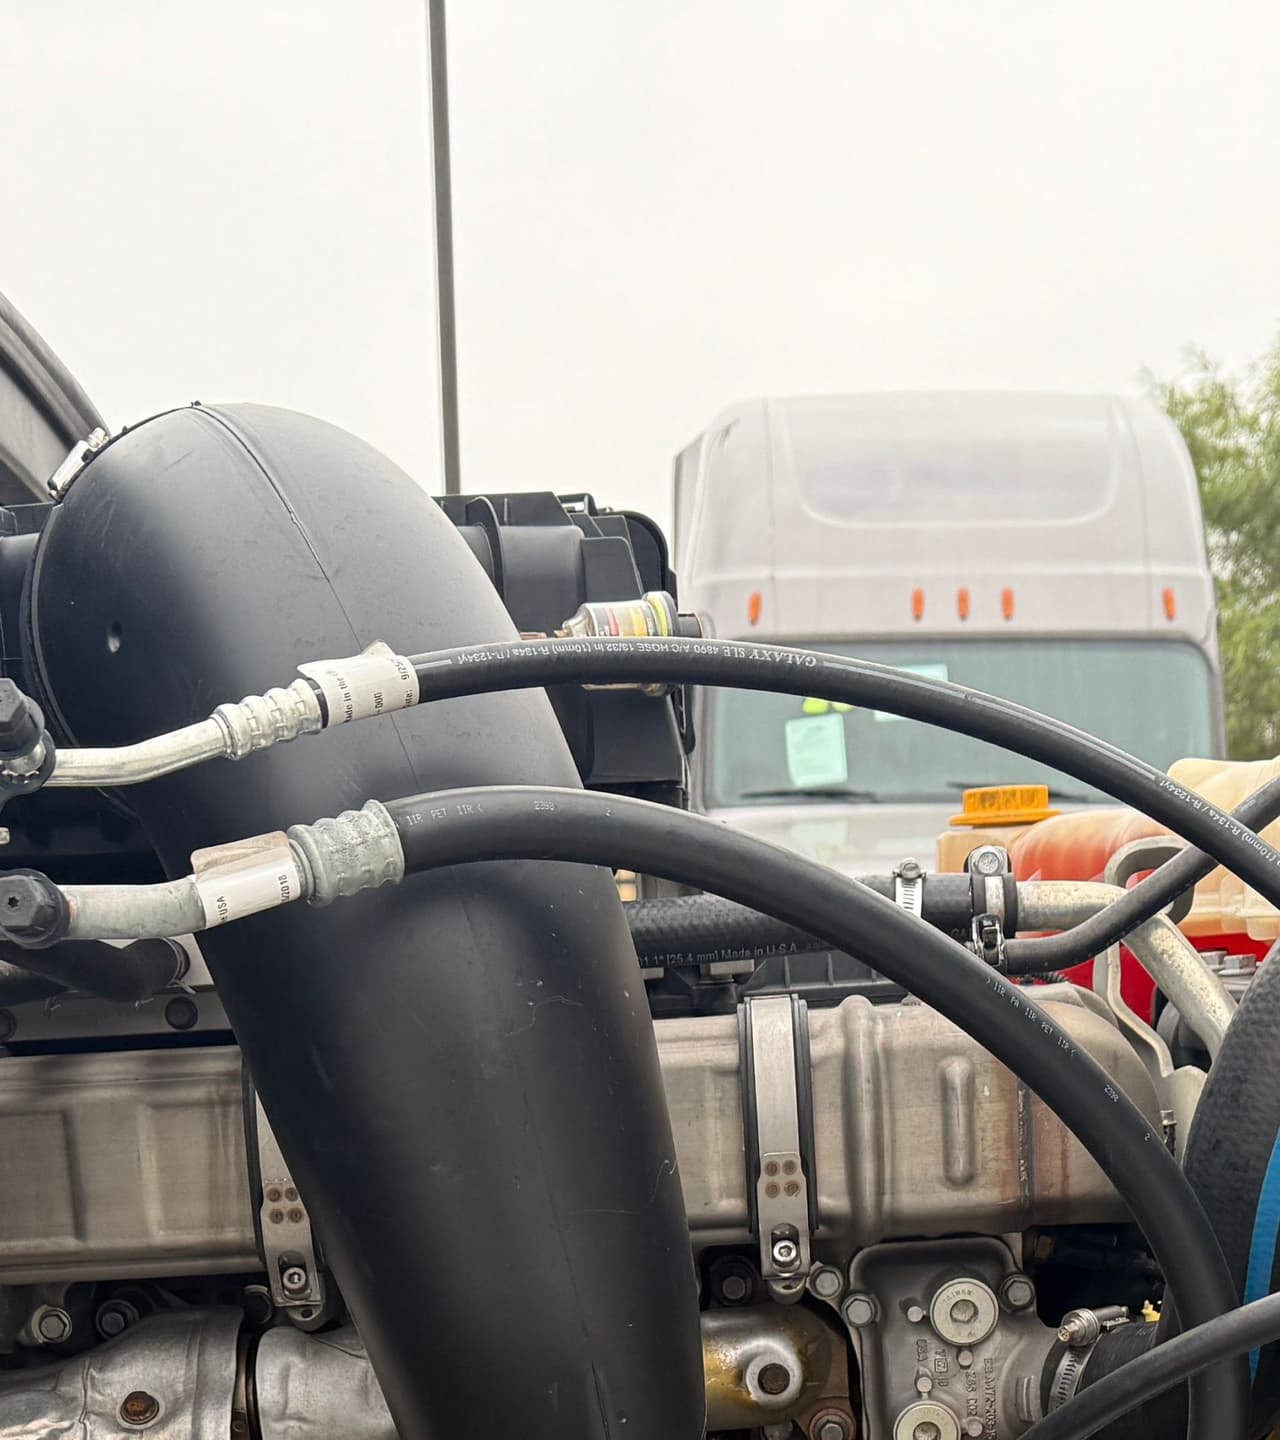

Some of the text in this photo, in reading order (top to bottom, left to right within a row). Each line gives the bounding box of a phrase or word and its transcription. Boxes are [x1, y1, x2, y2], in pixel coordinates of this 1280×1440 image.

[637, 642, 669, 652] HOSE
[722, 645, 745, 658] SLE
[749, 647, 817, 667] GALAXY
[1241, 831, 1276, 862] (10mm)
[216, 895, 228, 918] USA
[721, 947, 751, 960] Made
